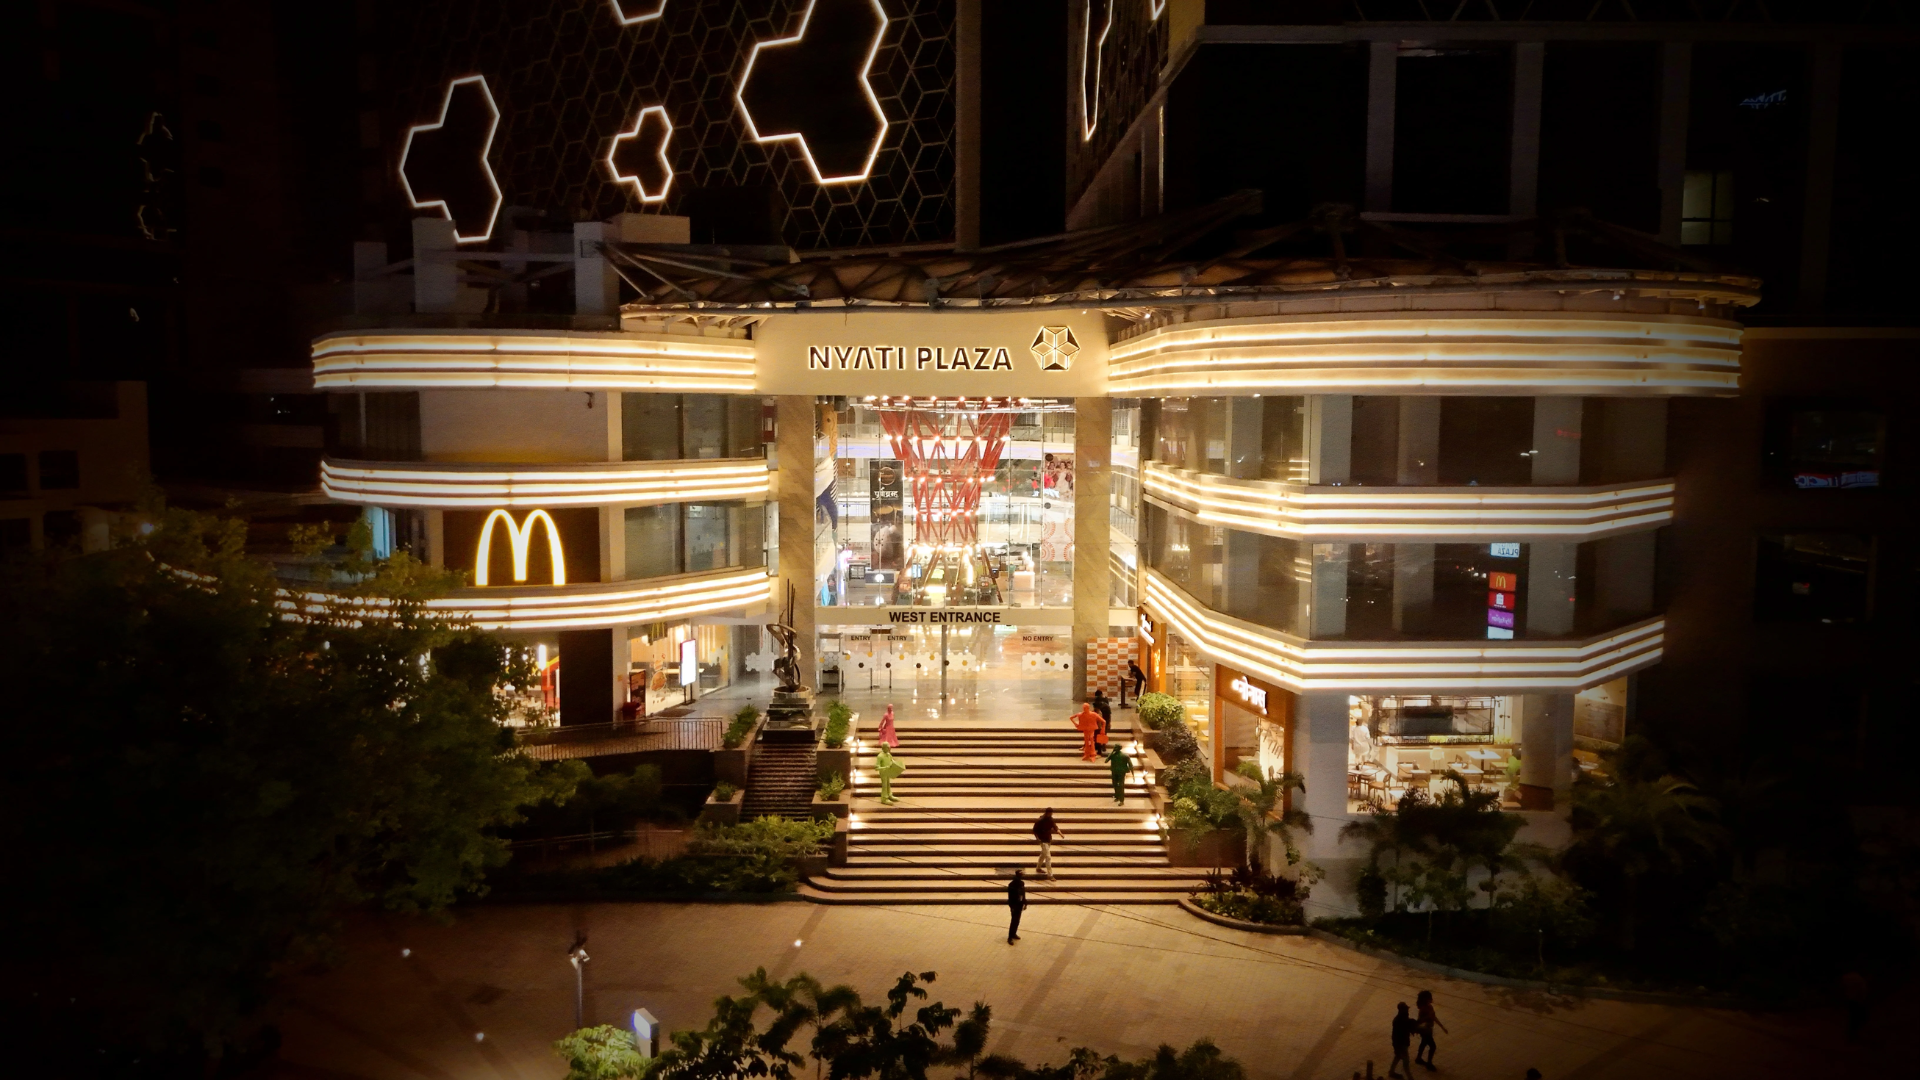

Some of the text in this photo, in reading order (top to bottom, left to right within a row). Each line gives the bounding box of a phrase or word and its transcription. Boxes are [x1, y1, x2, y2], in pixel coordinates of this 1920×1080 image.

[808, 345, 1014, 371] NYATI PLAZA
[889, 611, 1001, 623] WEST ENTRANCE
